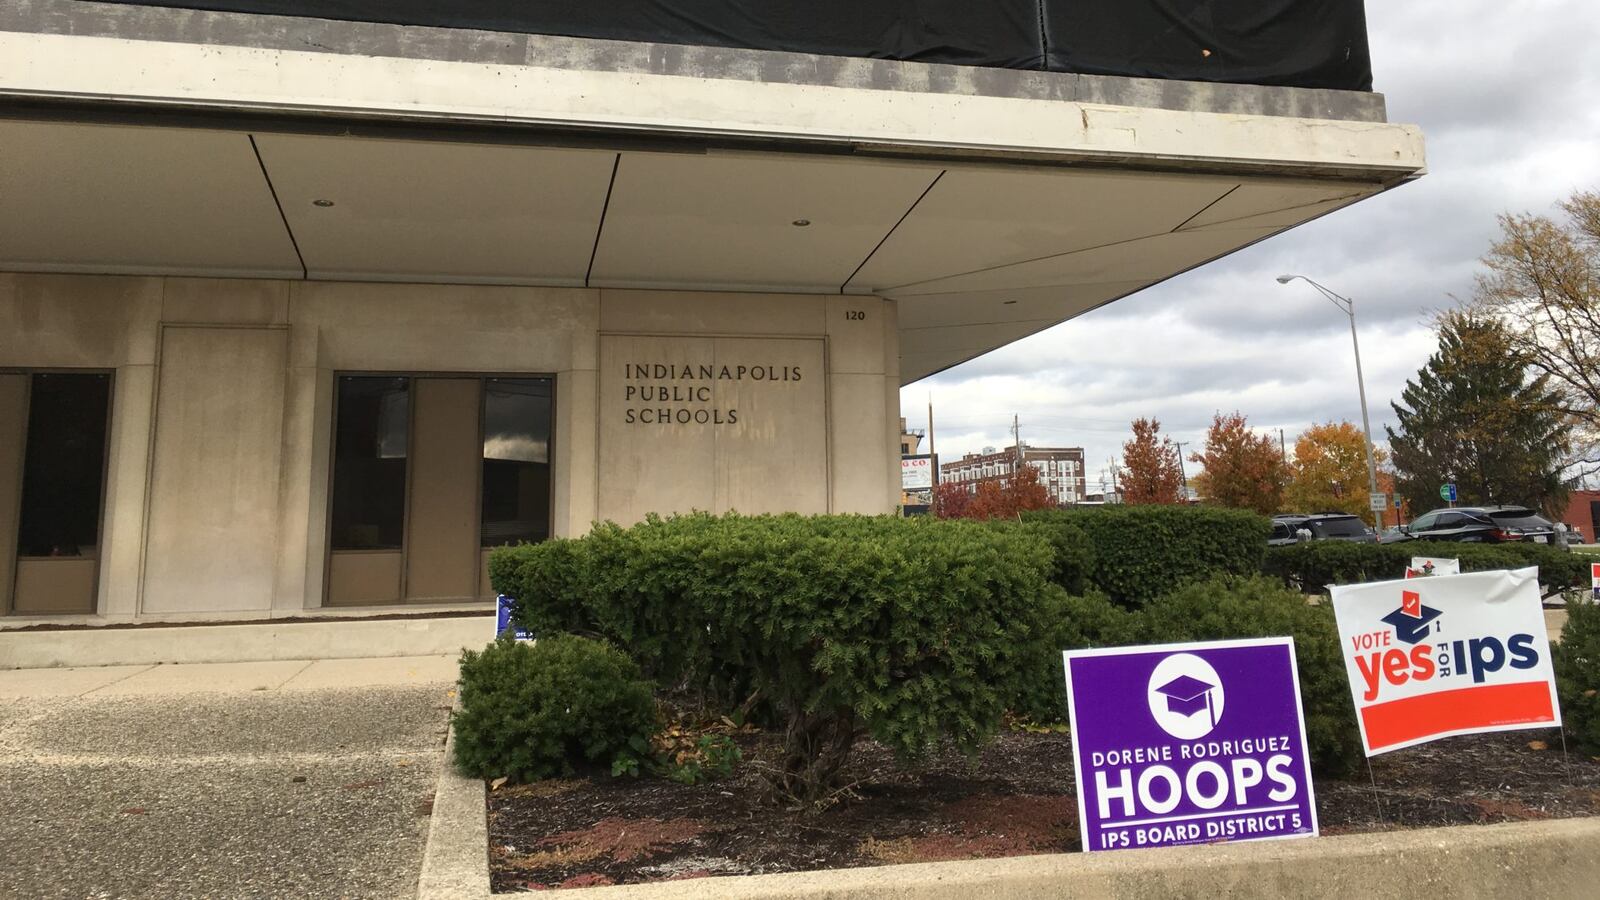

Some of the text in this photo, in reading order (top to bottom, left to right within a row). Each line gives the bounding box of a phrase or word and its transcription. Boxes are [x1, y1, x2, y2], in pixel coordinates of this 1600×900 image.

[845, 311, 865, 321] 120
[625, 363, 802, 382] INDIANAPOLIS
[625, 385, 711, 402] PUBLIC
[625, 408, 738, 424] SCHOOLS
[1352, 630, 1391, 651] VOTE
[1354, 644, 1436, 702] yes
[1437, 642, 1451, 678] FOR
[1092, 736, 1291, 767] DORENE RODRIGUEZ
[1095, 754, 1297, 819] HOOPS
[1101, 830, 1130, 848] IPS
[1136, 824, 1201, 843] BOARD
[1206, 815, 1286, 837] DISTRICT
[1292, 813, 1302, 828] 5
